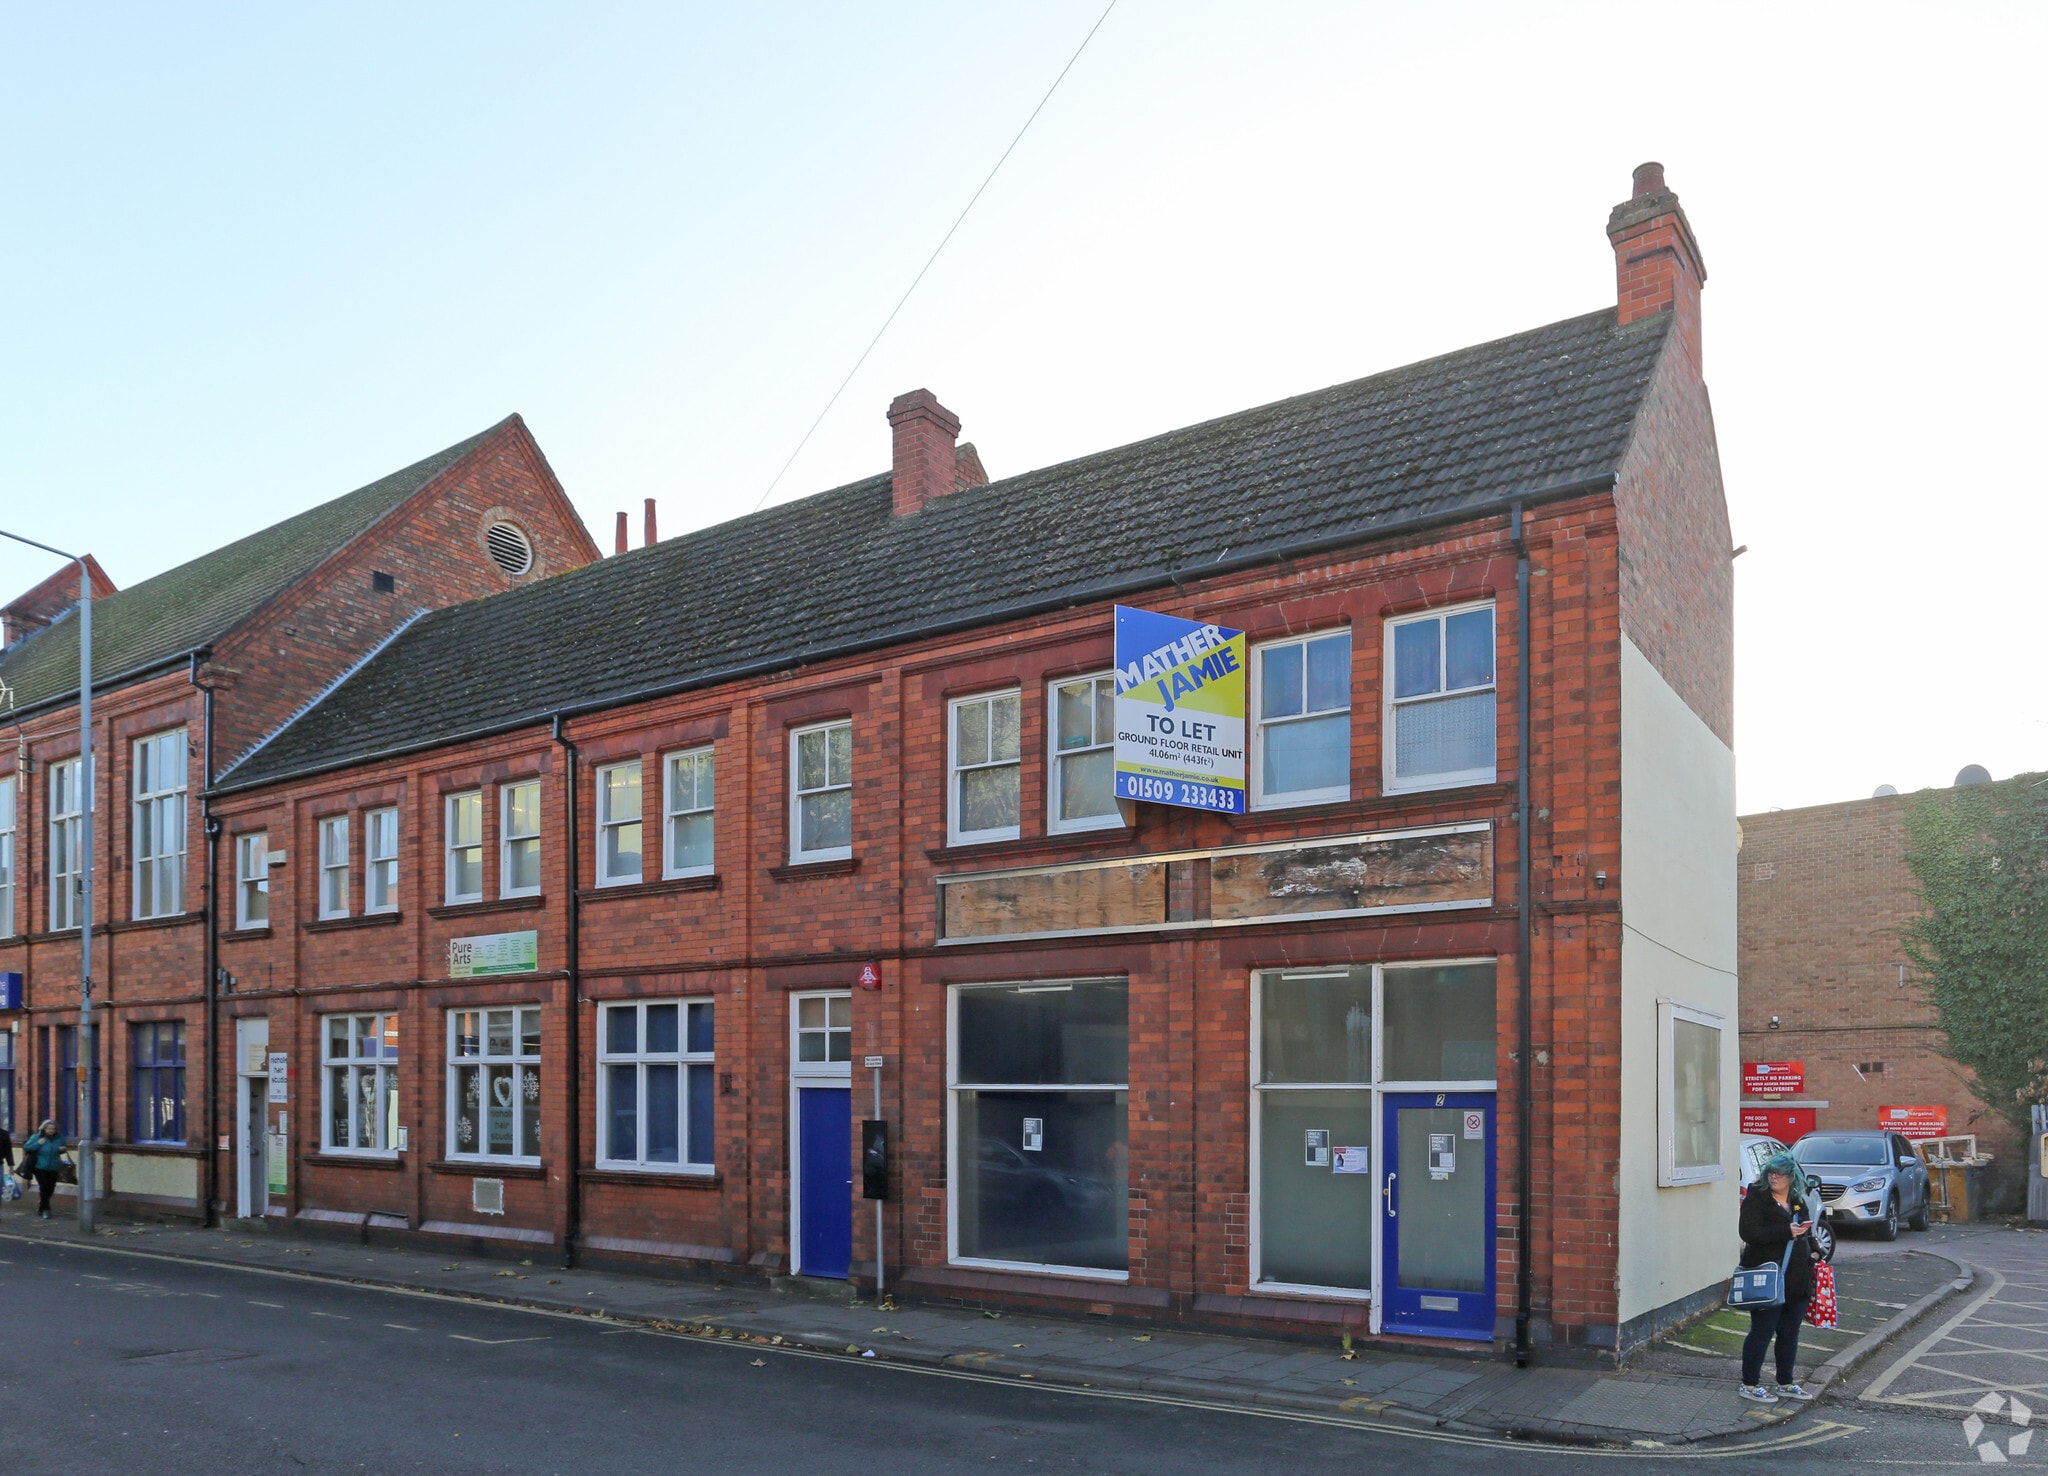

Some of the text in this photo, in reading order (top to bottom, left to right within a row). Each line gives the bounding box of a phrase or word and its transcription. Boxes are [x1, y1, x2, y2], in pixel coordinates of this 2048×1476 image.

[1117, 624, 1226, 693] MATHER
[1156, 646, 1240, 712] JAMIE
[1146, 714, 1216, 741] TO LET
[1118, 732, 1243, 760] GROUND FLOOR RETAIL UNIT
[1140, 766, 1219, 784] www.matherjamie.co.uk
[1128, 776, 1234, 810] 01509 233433
[452, 942, 472, 954] Pure
[453, 953, 471, 965] Arts
[1437, 1095, 1444, 1105] 2
